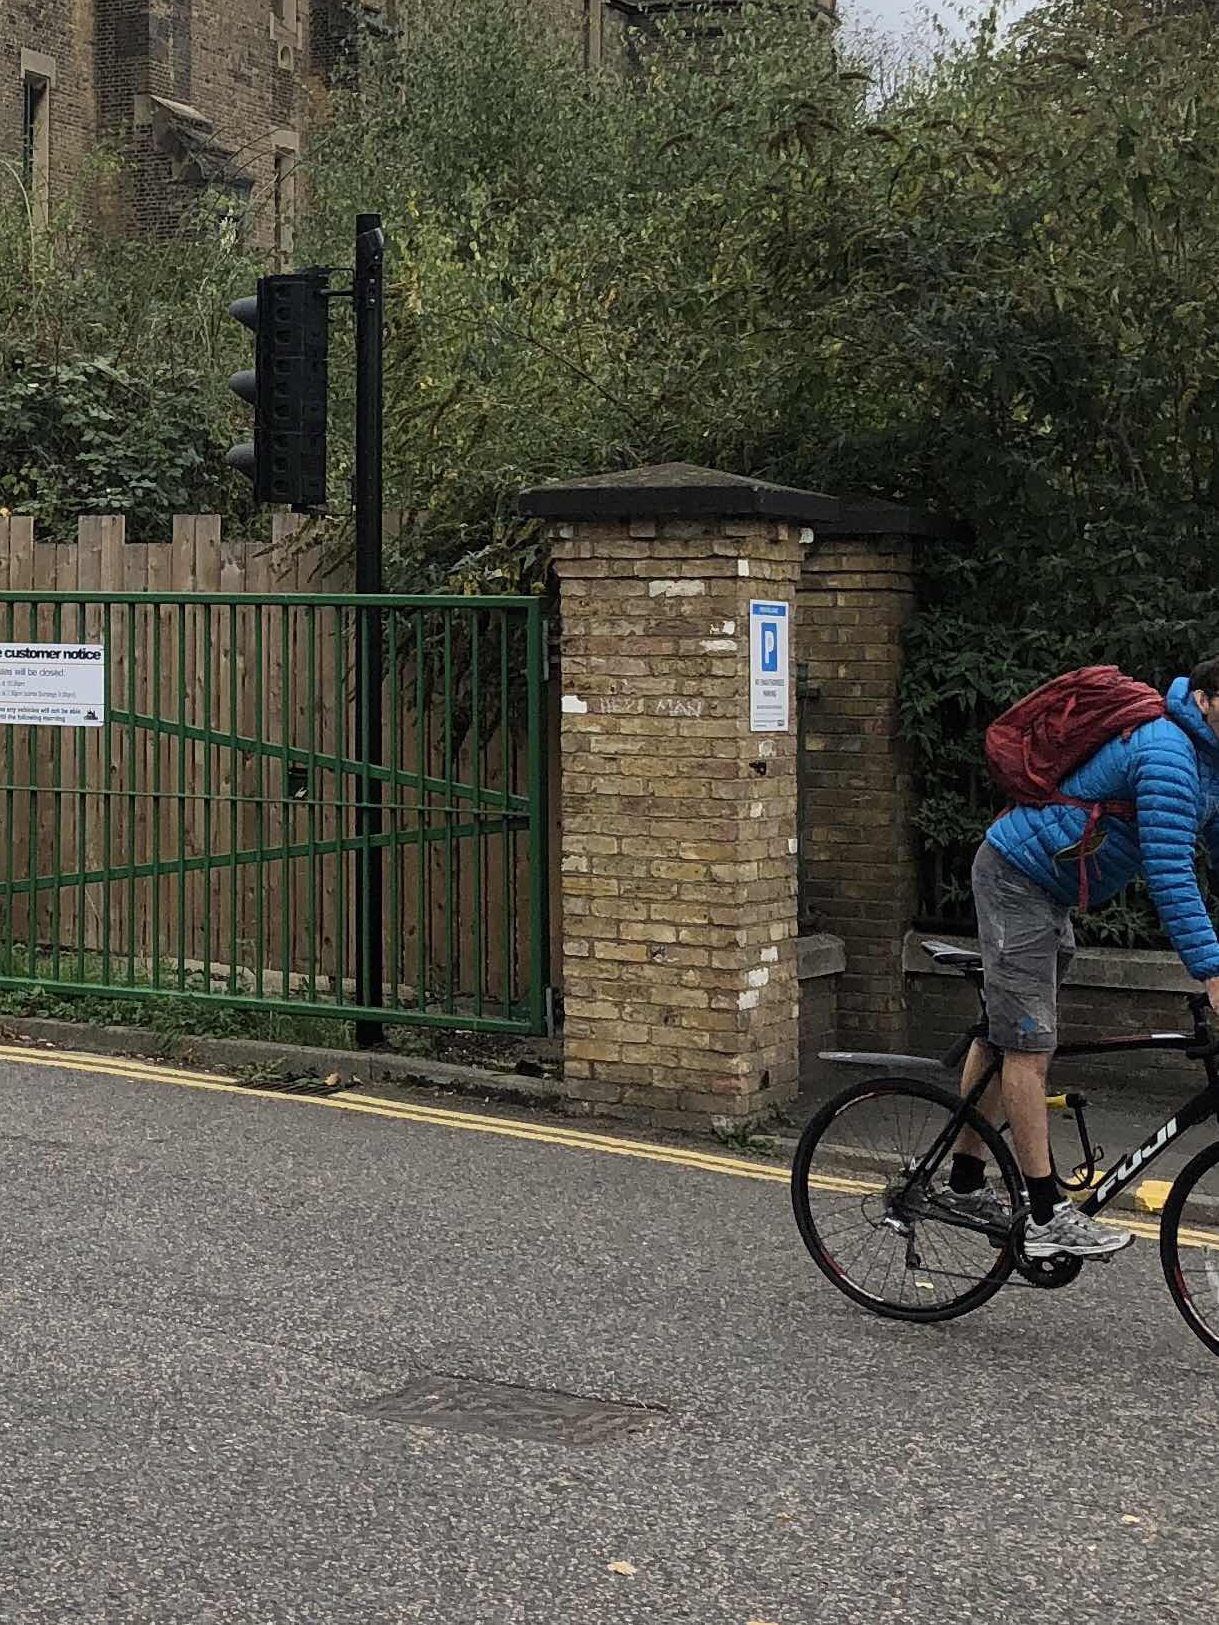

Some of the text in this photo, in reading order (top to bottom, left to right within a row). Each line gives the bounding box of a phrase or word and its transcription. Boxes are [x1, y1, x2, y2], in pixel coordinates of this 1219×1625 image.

[4, 647, 62, 660] customer
[63, 648, 101, 661] notice
[764, 630, 774, 664] P
[14, 667, 26, 676] will
[27, 668, 38, 677] be
[6, 707, 16, 715] any
[1097, 1116, 1178, 1203] FUJI
